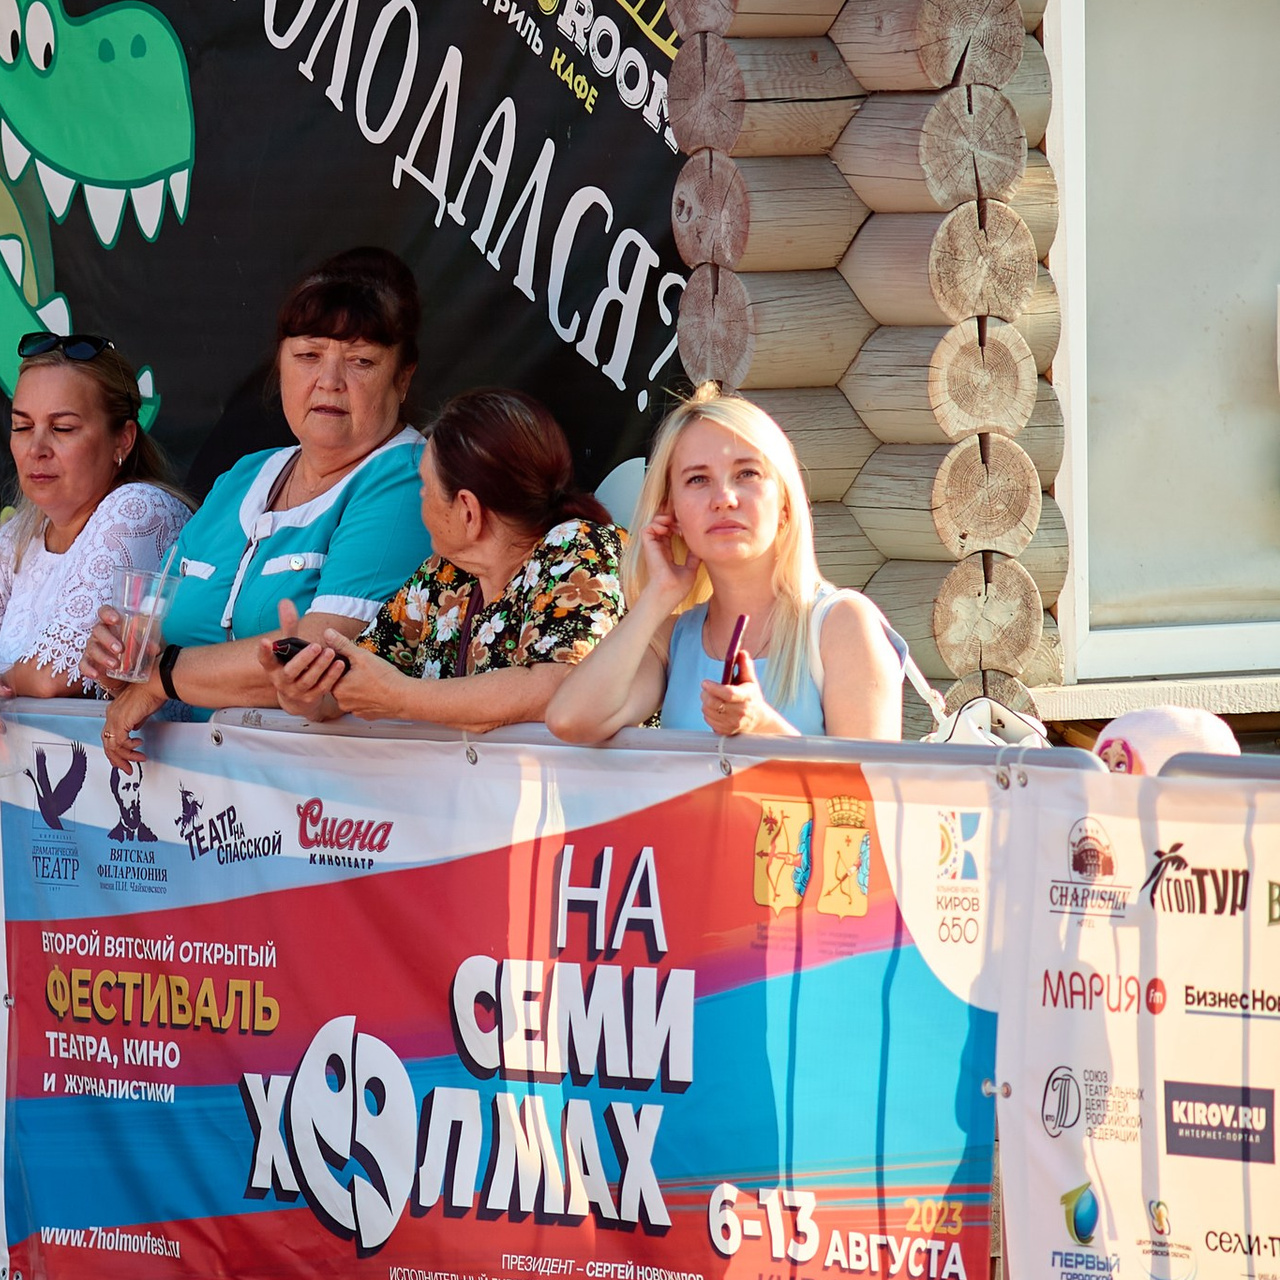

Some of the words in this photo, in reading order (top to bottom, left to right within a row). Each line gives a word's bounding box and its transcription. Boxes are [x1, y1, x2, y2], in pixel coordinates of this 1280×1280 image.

[550, 45, 599, 115] КАФЕ
[185, 804, 237, 861] ТЕАТР
[233, 822, 245, 839] НА
[297, 797, 393, 852] Смена
[32, 845, 78, 857] ДРАМАТИЧЕСКИЙ
[110, 848, 155, 864] ВЯТСКАЯ
[218, 831, 282, 866] СПАССКОЙ
[309, 852, 374, 870] КИНОТЕАТР
[32, 856, 79, 880] ТЕАТР
[97, 865, 168, 882] ФИЛАРМОНИЯ
[130, 881, 167, 894] Чайковского
[555, 844, 668, 956] НА
[1050, 885, 1130, 910] CHARUSHIN
[937, 896, 980, 911] КИРОВ
[938, 917, 979, 944] 650
[42, 930, 100, 956] ВТОРОЙ
[105, 935, 174, 962] ВЯТСКИЙ
[179, 941, 277, 968] ОТКРЫТЫЙ
[46, 965, 280, 1035] ФЕСТИВАЛЬ
[1042, 970, 1141, 1014] МАРИЯ
[1185, 986, 1249, 1010] Бизнес
[451, 954, 696, 1088] СЕМИ
[45, 1031, 118, 1069] ТЕАТРА,
[123, 1039, 181, 1068] КИНО
[43, 1073, 55, 1092] И
[64, 1074, 175, 1103] ЖУРНАЛИСТИКИ
[1083, 1070, 1108, 1082] СОЮЗ
[1084, 1084, 1144, 1100] ТЕАТРАЛЬНЫХ
[1085, 1098, 1128, 1114] ДЕЯТЕЛЕЙ
[1173, 1100, 1266, 1131] KIROV.RU
[1086, 1113, 1143, 1129] РОССИЙСКОЙ
[1086, 1127, 1138, 1144] ФЕДЕРАЦИИ
[1179, 1128, 1260, 1143] ИНТЕРНЕТ-ПОРТАЛ
[708, 1181, 820, 1262] 6-13
[904, 1198, 963, 1236] 2023
[40, 1226, 180, 1260] www.7holmovfest.ru
[502, 1254, 575, 1275] ПРЕЗИДЕНТ
[586, 1260, 634, 1280] СЕРГЕЙ
[1052, 1251, 1120, 1273] ПЕРВЫЙ
